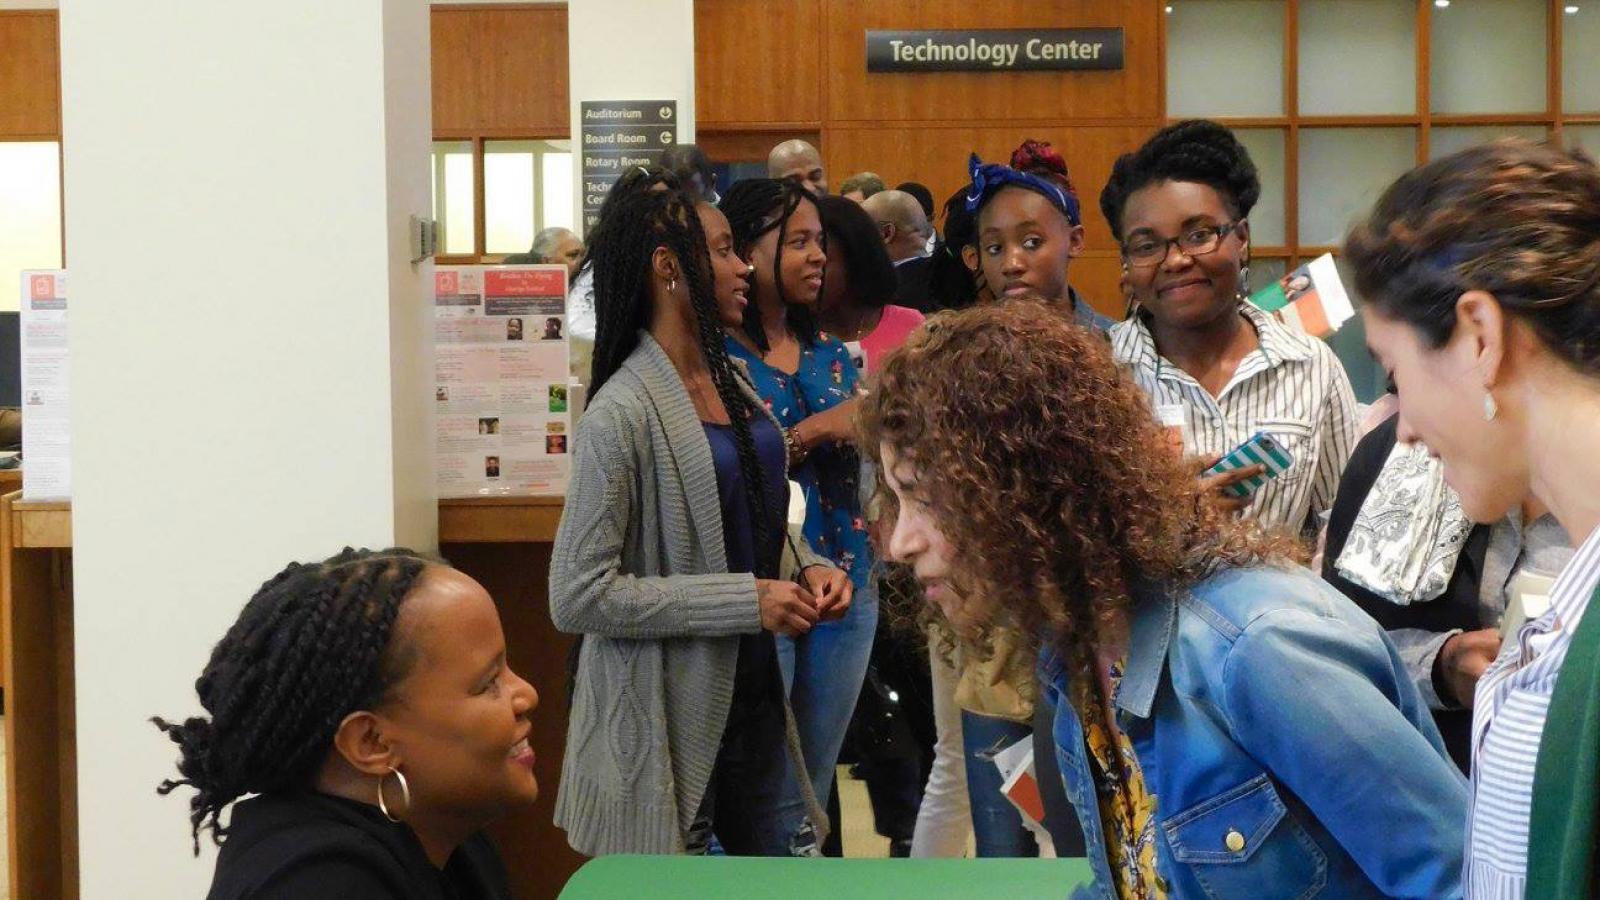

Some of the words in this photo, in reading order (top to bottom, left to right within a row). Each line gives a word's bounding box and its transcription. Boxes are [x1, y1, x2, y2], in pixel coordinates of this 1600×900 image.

[889, 38, 1019, 66] Technology
[1026, 38, 1103, 60] Center
[585, 109, 642, 119] Auditorium
[585, 133, 614, 143] Board
[617, 133, 647, 143] Room
[585, 157, 618, 168] Rotary
[620, 157, 651, 166] Room
